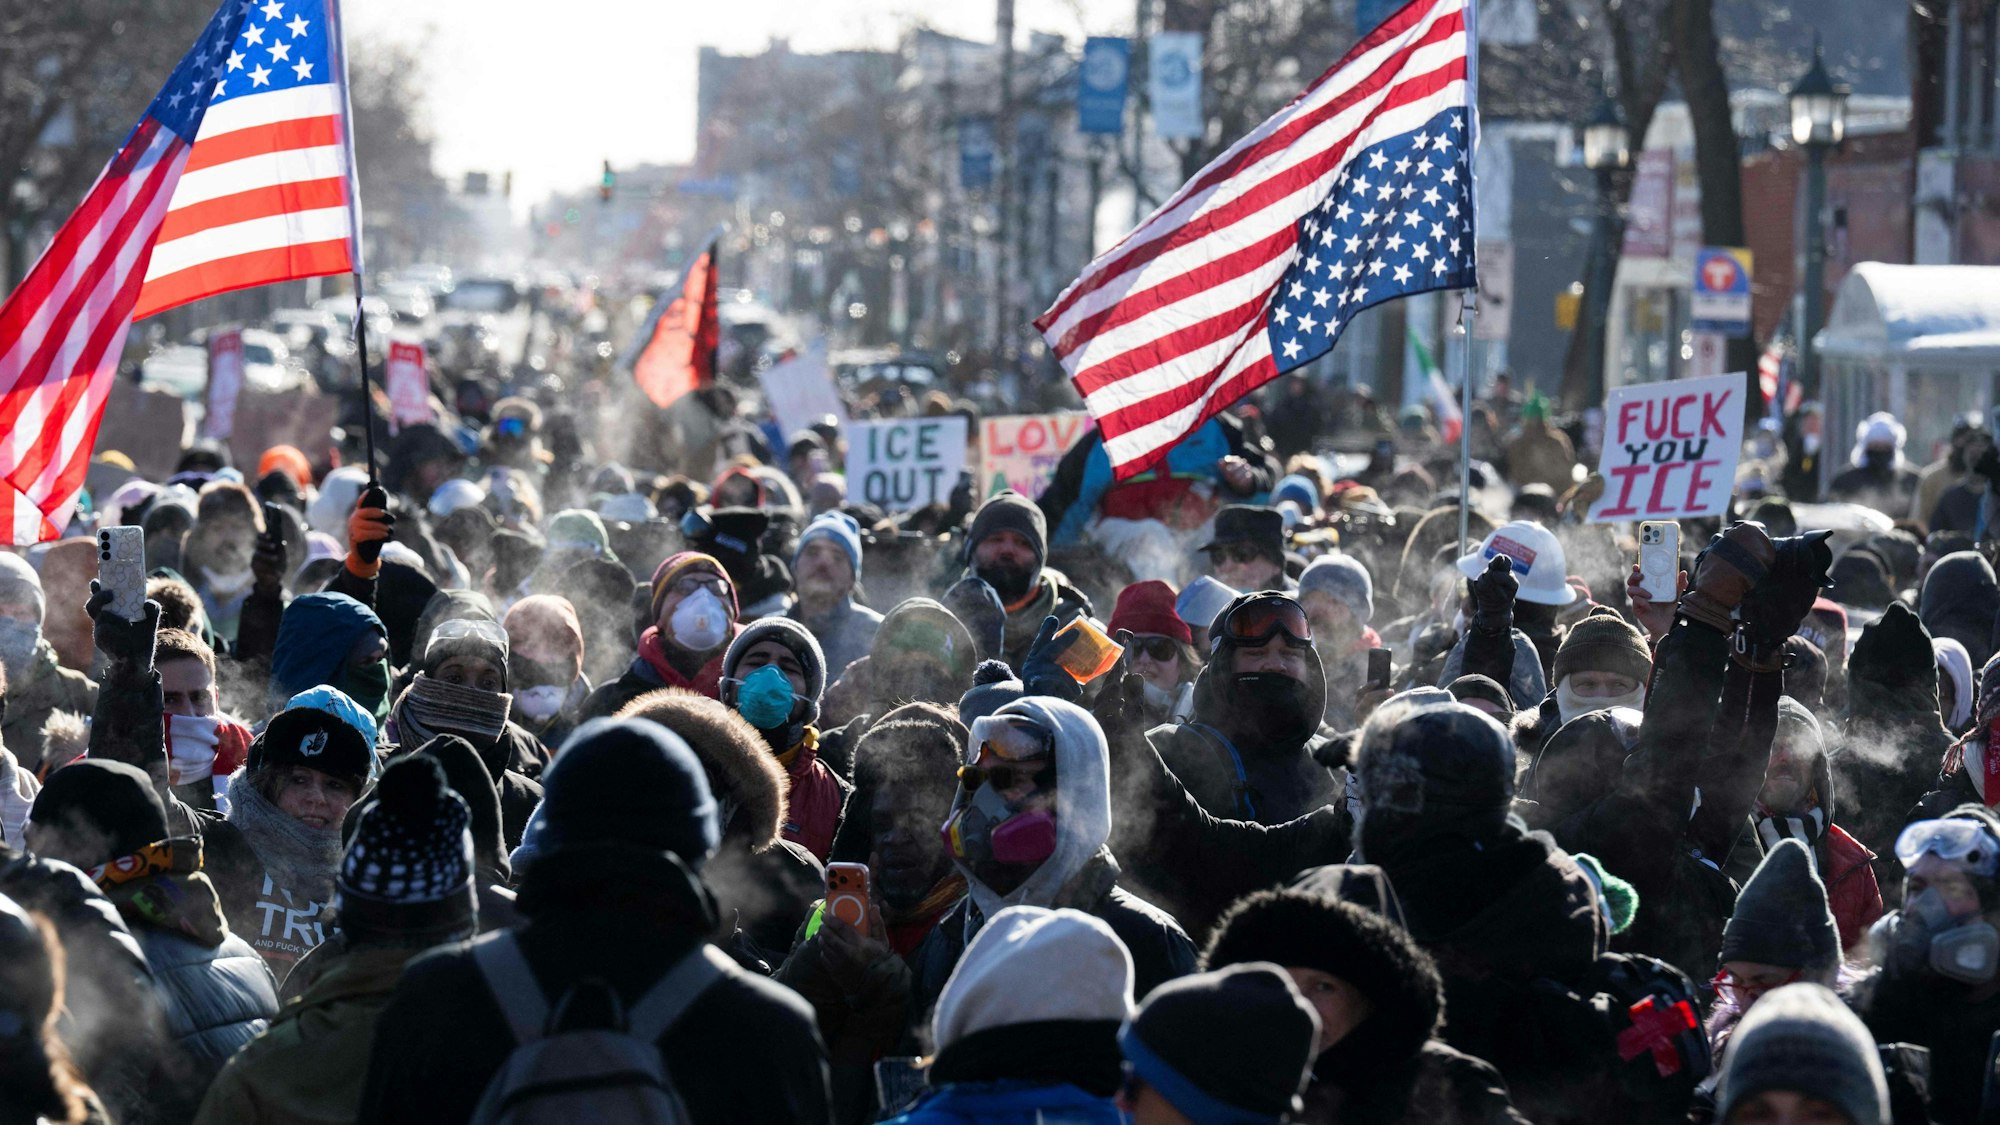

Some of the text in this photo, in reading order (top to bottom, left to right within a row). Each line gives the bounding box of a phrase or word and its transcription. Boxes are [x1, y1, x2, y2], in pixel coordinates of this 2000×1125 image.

[1617, 389, 1732, 444] FUCK
[868, 424, 939, 464] ICE
[1624, 438, 1709, 465] YOU
[864, 469, 944, 507] OUT
[1597, 460, 1721, 518] ICE
[254, 939, 274, 948] AND
[275, 942, 300, 953] FUCK
